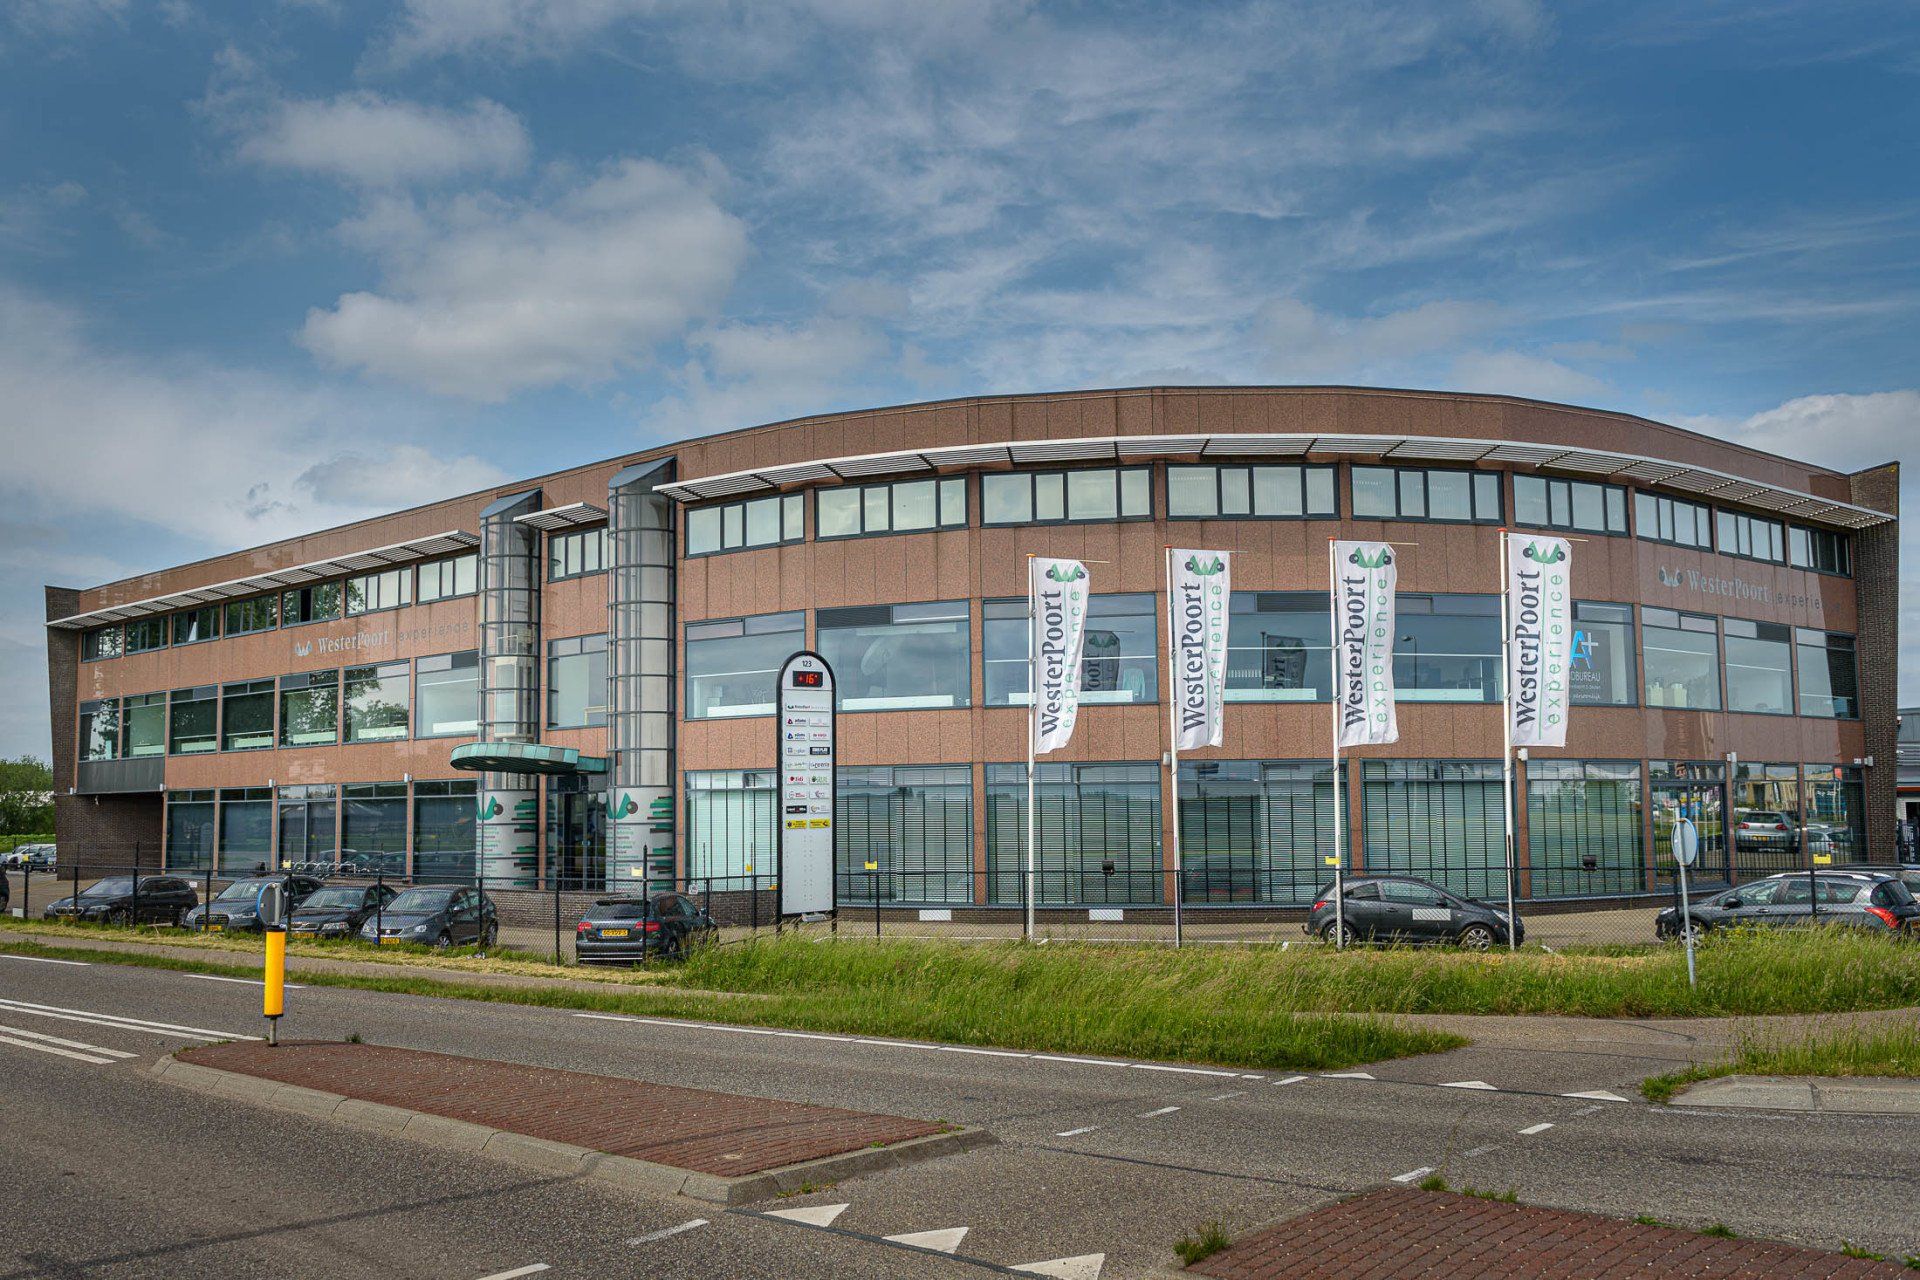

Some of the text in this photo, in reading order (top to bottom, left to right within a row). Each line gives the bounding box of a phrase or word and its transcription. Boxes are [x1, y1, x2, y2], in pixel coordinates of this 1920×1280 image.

[317, 622, 469, 654] WesterPoort experience
[1181, 582, 1205, 732] WesterPoort
[1342, 575, 1366, 729] WesterPoort
[1370, 578, 1388, 723] experience
[1515, 570, 1541, 727] WesterPoort
[1546, 574, 1563, 724] experience
[1686, 569, 1770, 603] WesterPoort
[1040, 590, 1066, 736] WesterPoort
[1063, 591, 1081, 728] expernce
